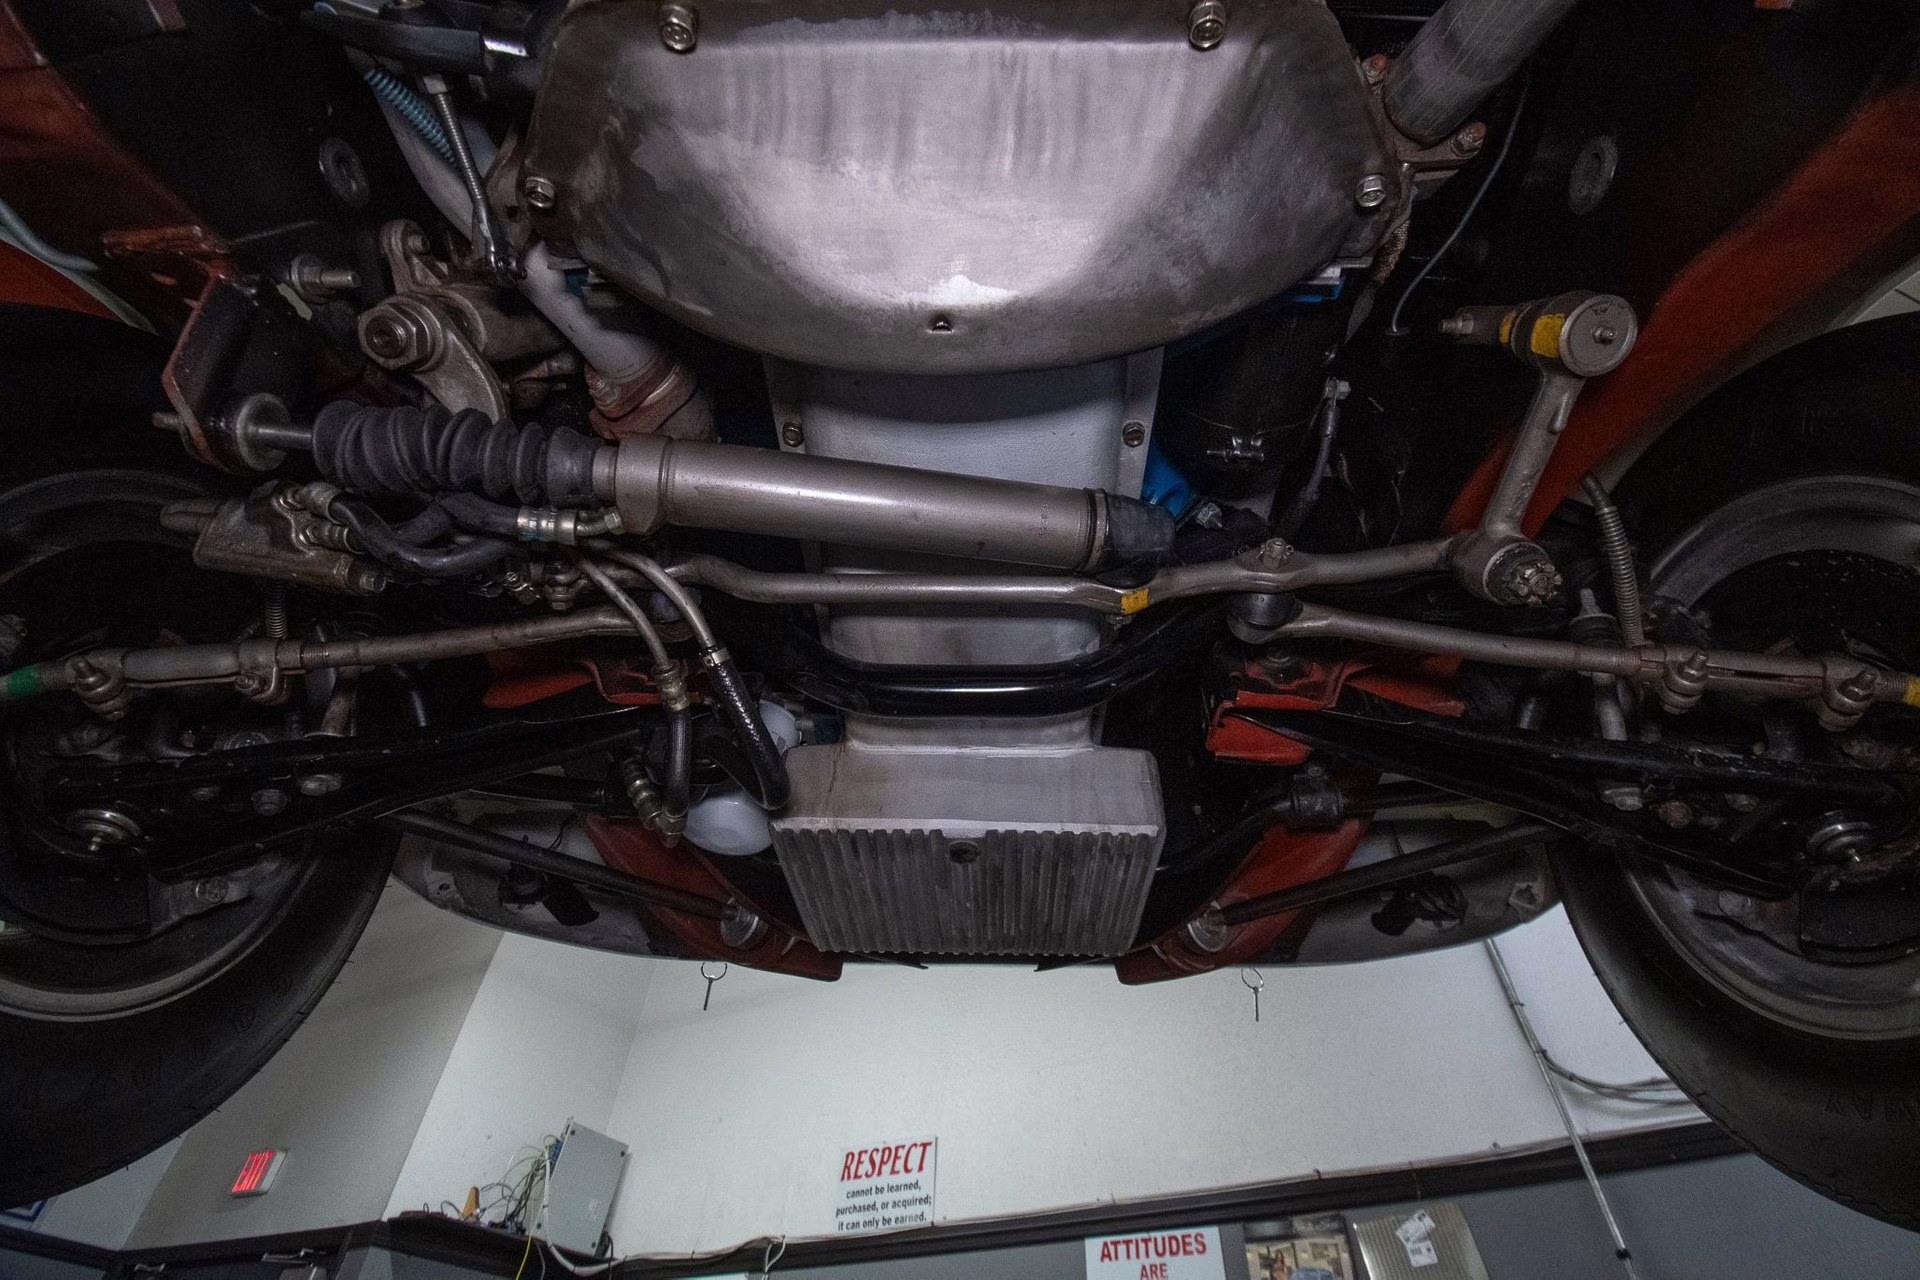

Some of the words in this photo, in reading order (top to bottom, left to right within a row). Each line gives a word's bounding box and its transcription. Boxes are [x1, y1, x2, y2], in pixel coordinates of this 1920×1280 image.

[232, 1151, 274, 1193] EXIT
[841, 1141, 933, 1182] RESPECT
[846, 1185, 873, 1199] cannot
[875, 1184, 885, 1195] be
[887, 1180, 921, 1193] learned,
[835, 1201, 879, 1218] purchased,
[881, 1202, 889, 1210] or
[892, 1194, 932, 1210] acquired;
[838, 1220, 844, 1231] it
[846, 1221, 860, 1231] can
[862, 1216, 880, 1229] only
[882, 1215, 892, 1226] be
[894, 1210, 927, 1225] earned.
[1100, 1232, 1207, 1262] ATTITUDES
[1140, 1263, 1168, 1280] ARE
